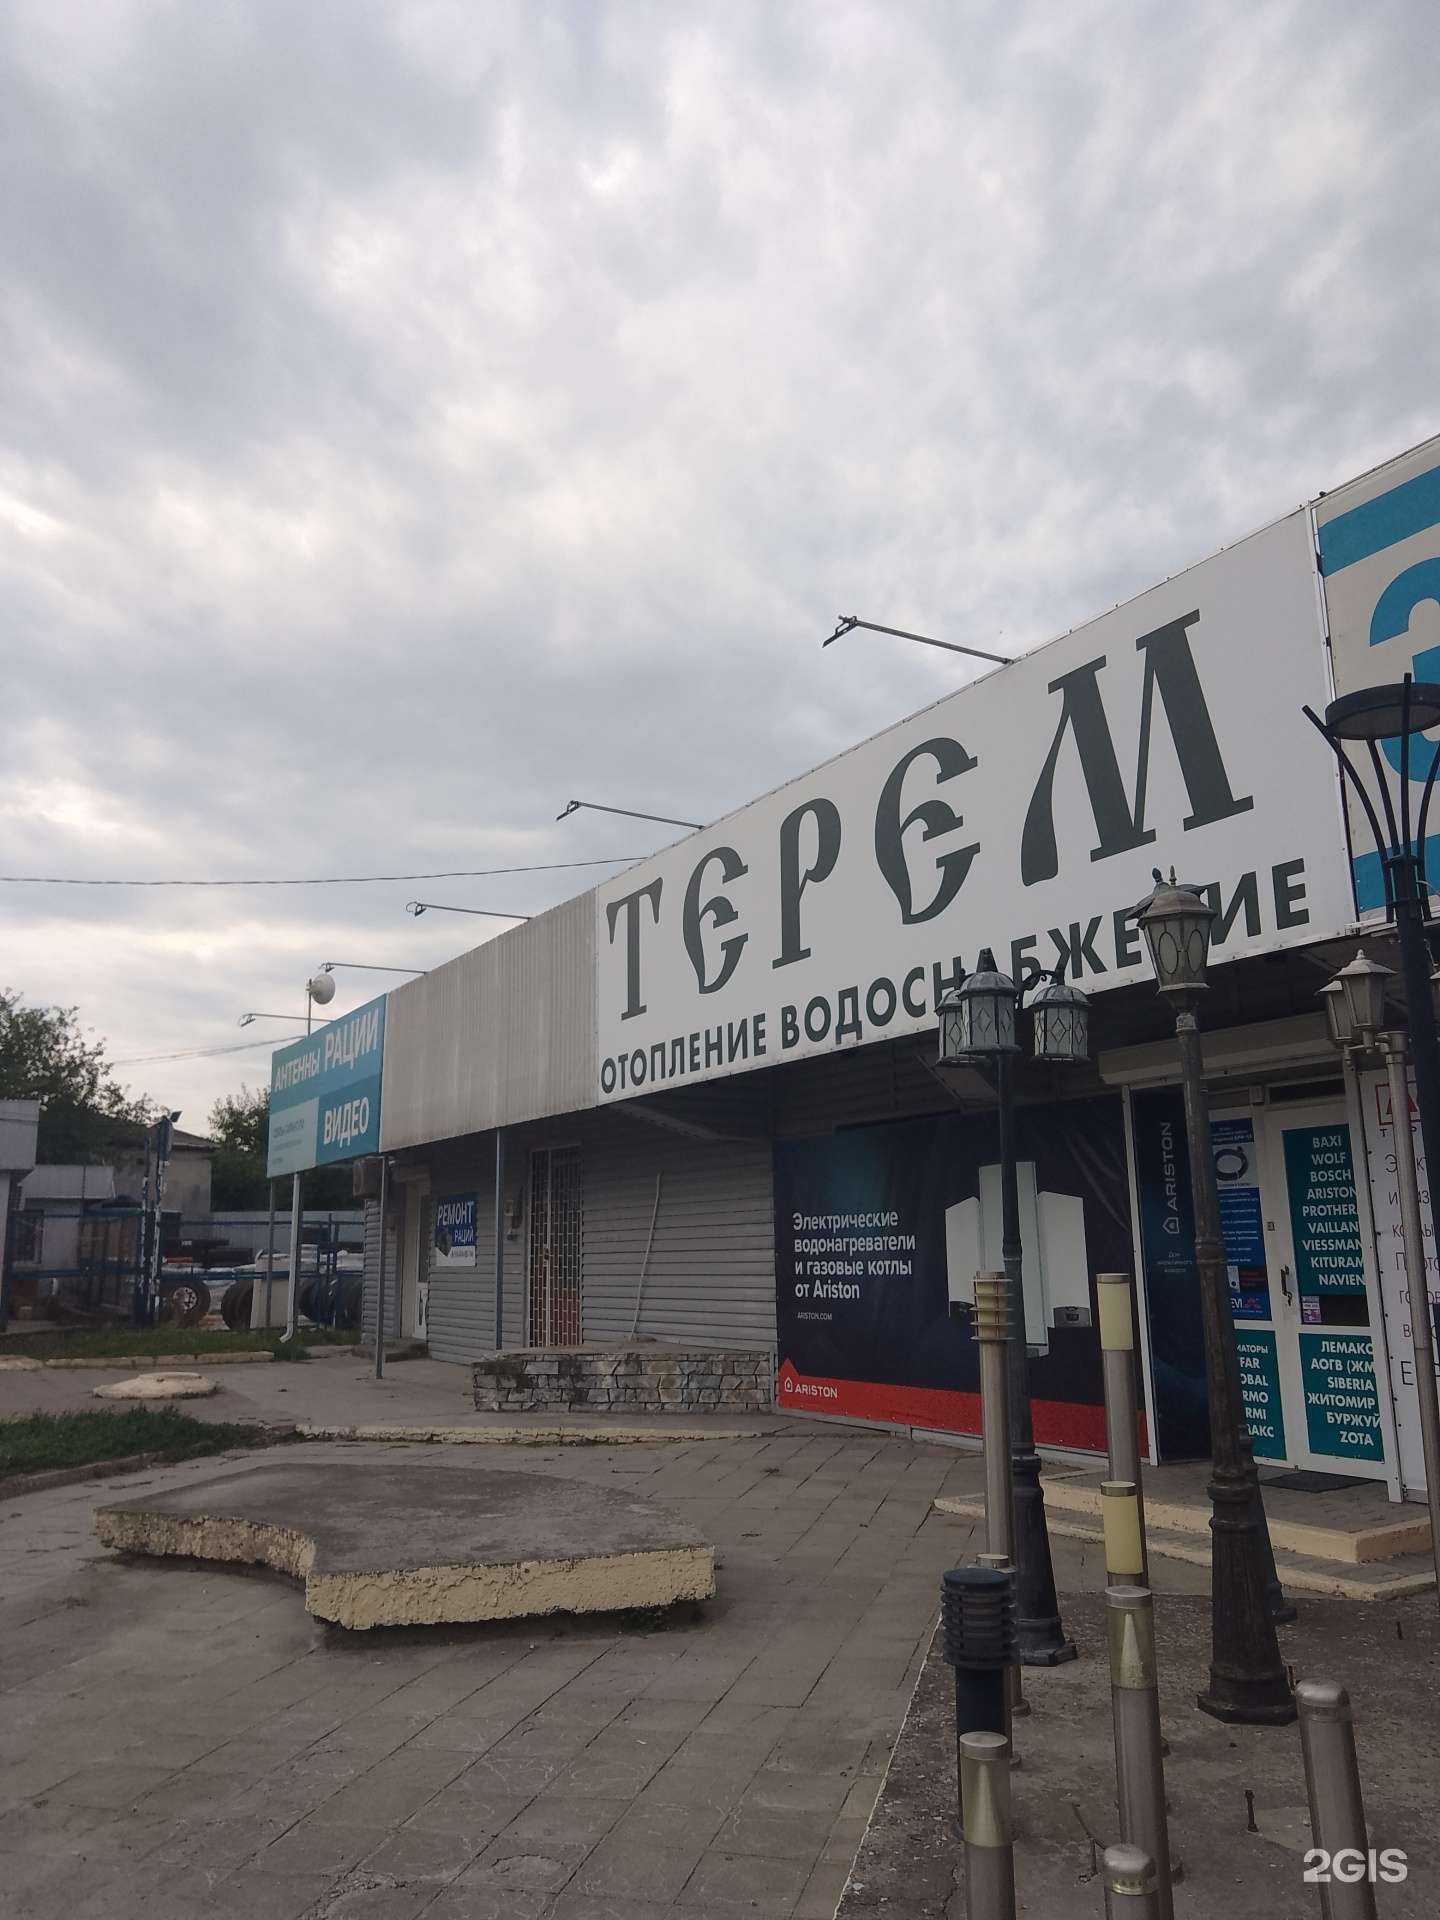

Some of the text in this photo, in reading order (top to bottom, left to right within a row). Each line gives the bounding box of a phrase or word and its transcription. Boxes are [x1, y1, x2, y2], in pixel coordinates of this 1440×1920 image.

[601, 858, 1310, 1094] ОТОПЛЕНИЕ ВОДОСНБЖЕИЕ
[275, 1008, 379, 1092] АНТЕННЫ РАЦИИ
[323, 1097, 369, 1148] ВИДЕО
[1312, 1135, 1342, 1149] BAXI
[1311, 1152, 1346, 1166] WOLF
[1160, 1122, 1178, 1212] ARISTON
[1310, 1168, 1351, 1182] BOSCH
[1306, 1186, 1357, 1200] ARISTON
[437, 1201, 475, 1226] РЕМОНТ
[1302, 1203, 1358, 1217] PROTHER
[792, 1211, 899, 1234] Электрические
[794, 1235, 916, 1256] водонагреватели
[795, 1260, 912, 1275] и газовые котлы
[795, 1280, 860, 1299] от Ariston
[797, 1312, 832, 1320] ARISTON.COM
[1240, 1356, 1260, 1369] FAR
[1311, 1358, 1343, 1371] АОГВ
[1240, 1373, 1268, 1386] OBAL
[1327, 1376, 1375, 1391] SIBERIA
[794, 1383, 838, 1398] ARISTON
[1242, 1390, 1268, 1403] RMO
[1307, 1392, 1376, 1409] ЖИТОМИР
[1245, 1407, 1267, 1420] RMI
[1326, 1411, 1381, 1428] БУРЖУЙ
[1339, 1431, 1374, 1446] ZOTA
